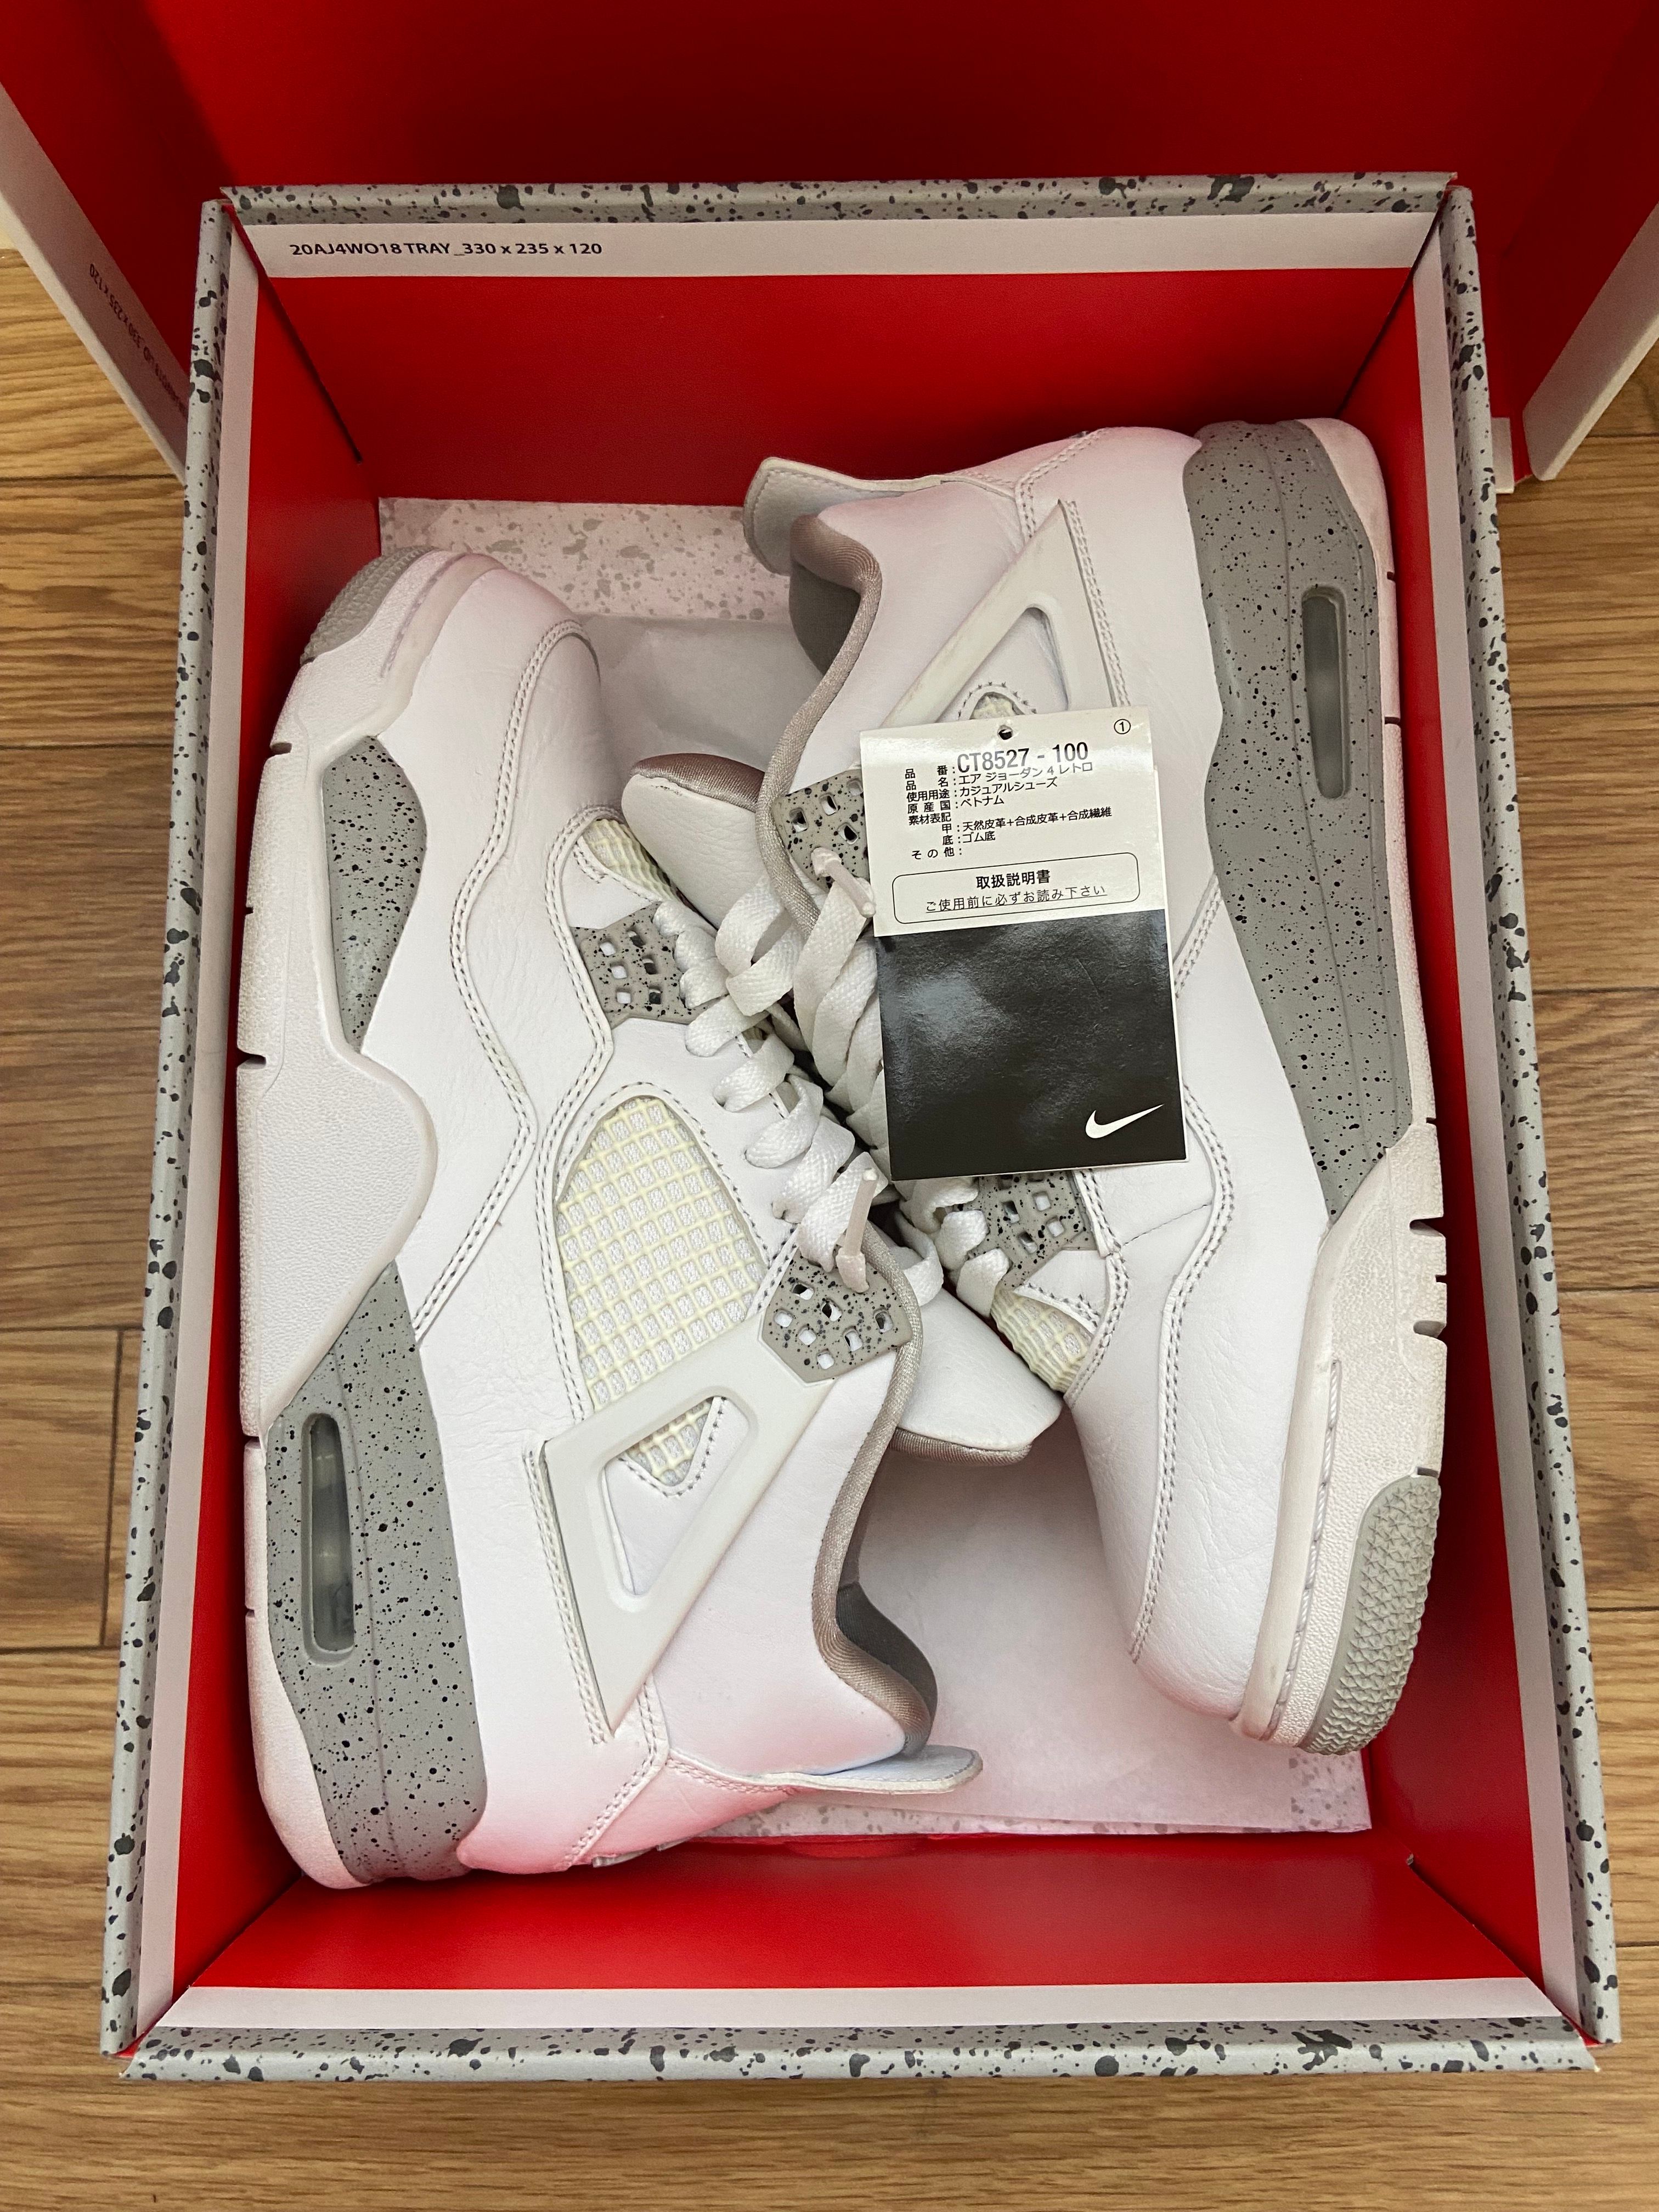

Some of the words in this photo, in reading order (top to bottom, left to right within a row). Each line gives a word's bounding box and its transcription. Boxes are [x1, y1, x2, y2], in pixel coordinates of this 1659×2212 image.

[403, 242, 450, 254] TRAY
[501, 246, 511, 254] x
[515, 243, 549, 255] 235
[554, 245, 565, 254] x
[569, 243, 602, 255] 120
[90, 263, 102, 290] 120
[957, 748, 1029, 773] CT8527
[1052, 742, 1088, 763] 100
[961, 795, 1005, 808] ベトナム
[909, 812, 951, 826] 素材表記
[962, 831, 996, 843] ゴム底
[976, 870, 1051, 889] 取扱説明書
[926, 885, 1105, 912] ご使用前に必ずお読み下さい
